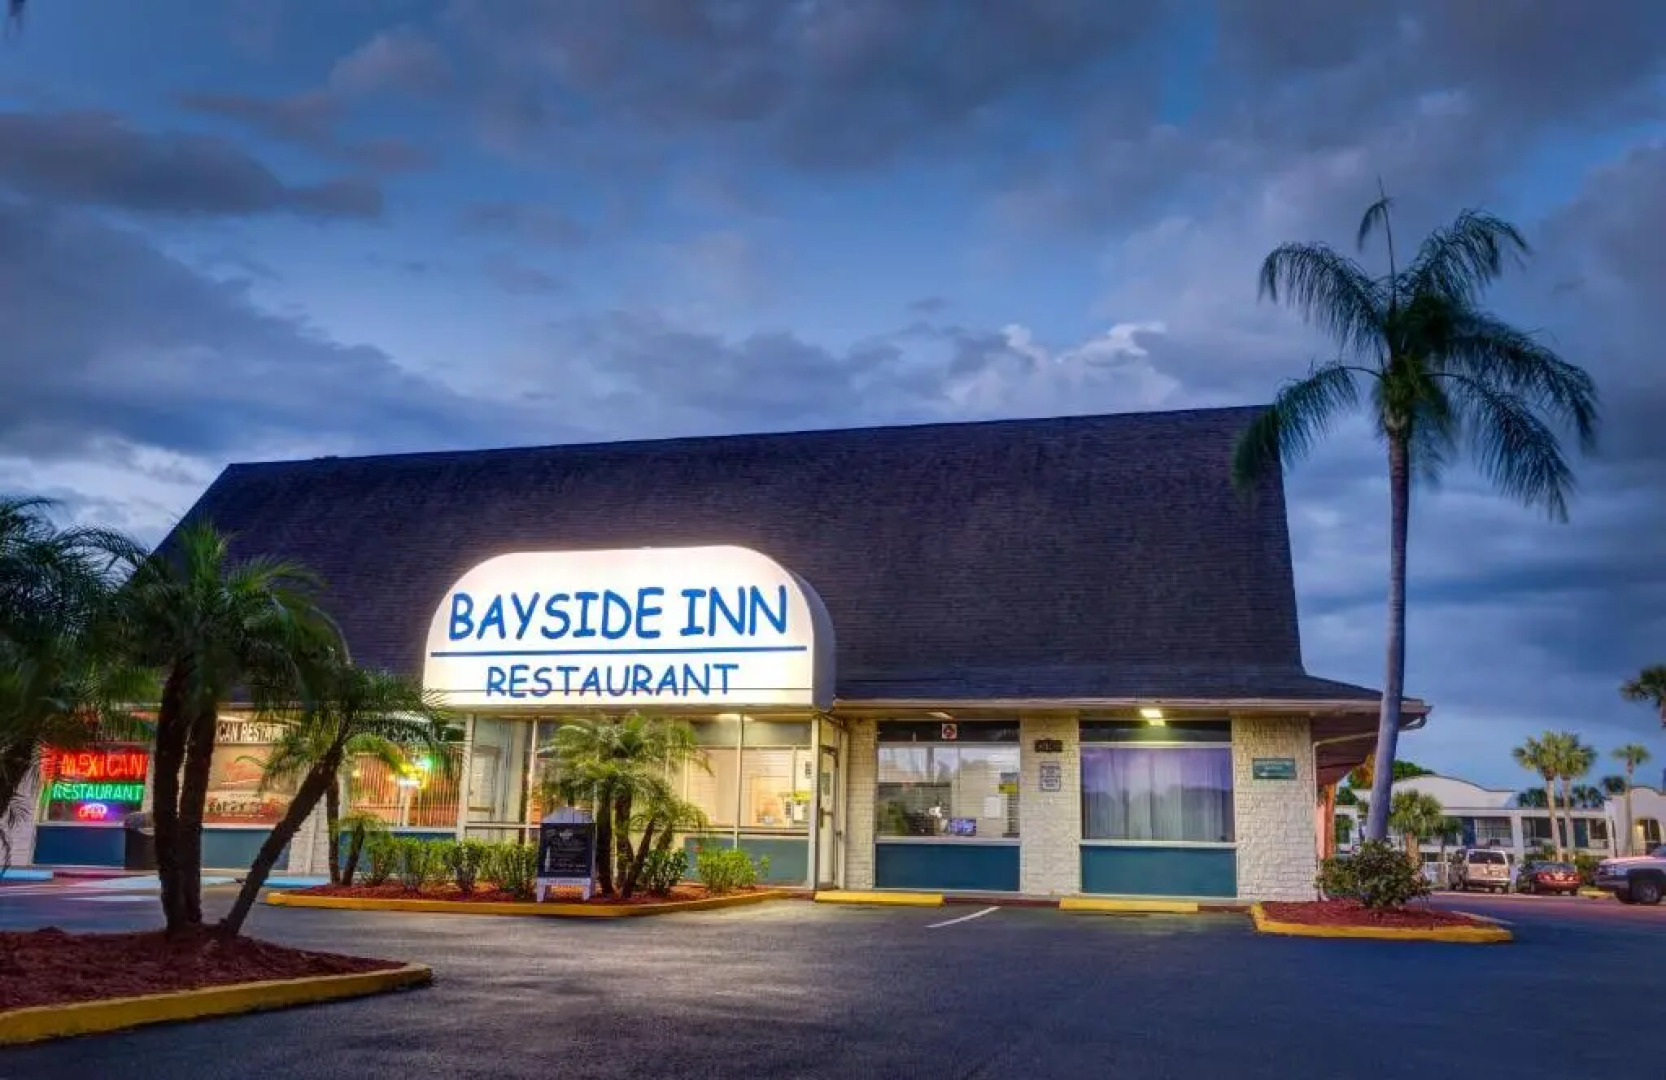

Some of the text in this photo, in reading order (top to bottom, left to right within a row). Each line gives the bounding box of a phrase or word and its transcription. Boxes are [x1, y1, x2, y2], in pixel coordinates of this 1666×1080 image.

[448, 584, 787, 641] BAYSIDE INN
[486, 664, 739, 698] RESTAURANT
[61, 754, 143, 777] MEXICAN
[53, 783, 144, 800] RESTAURANT
